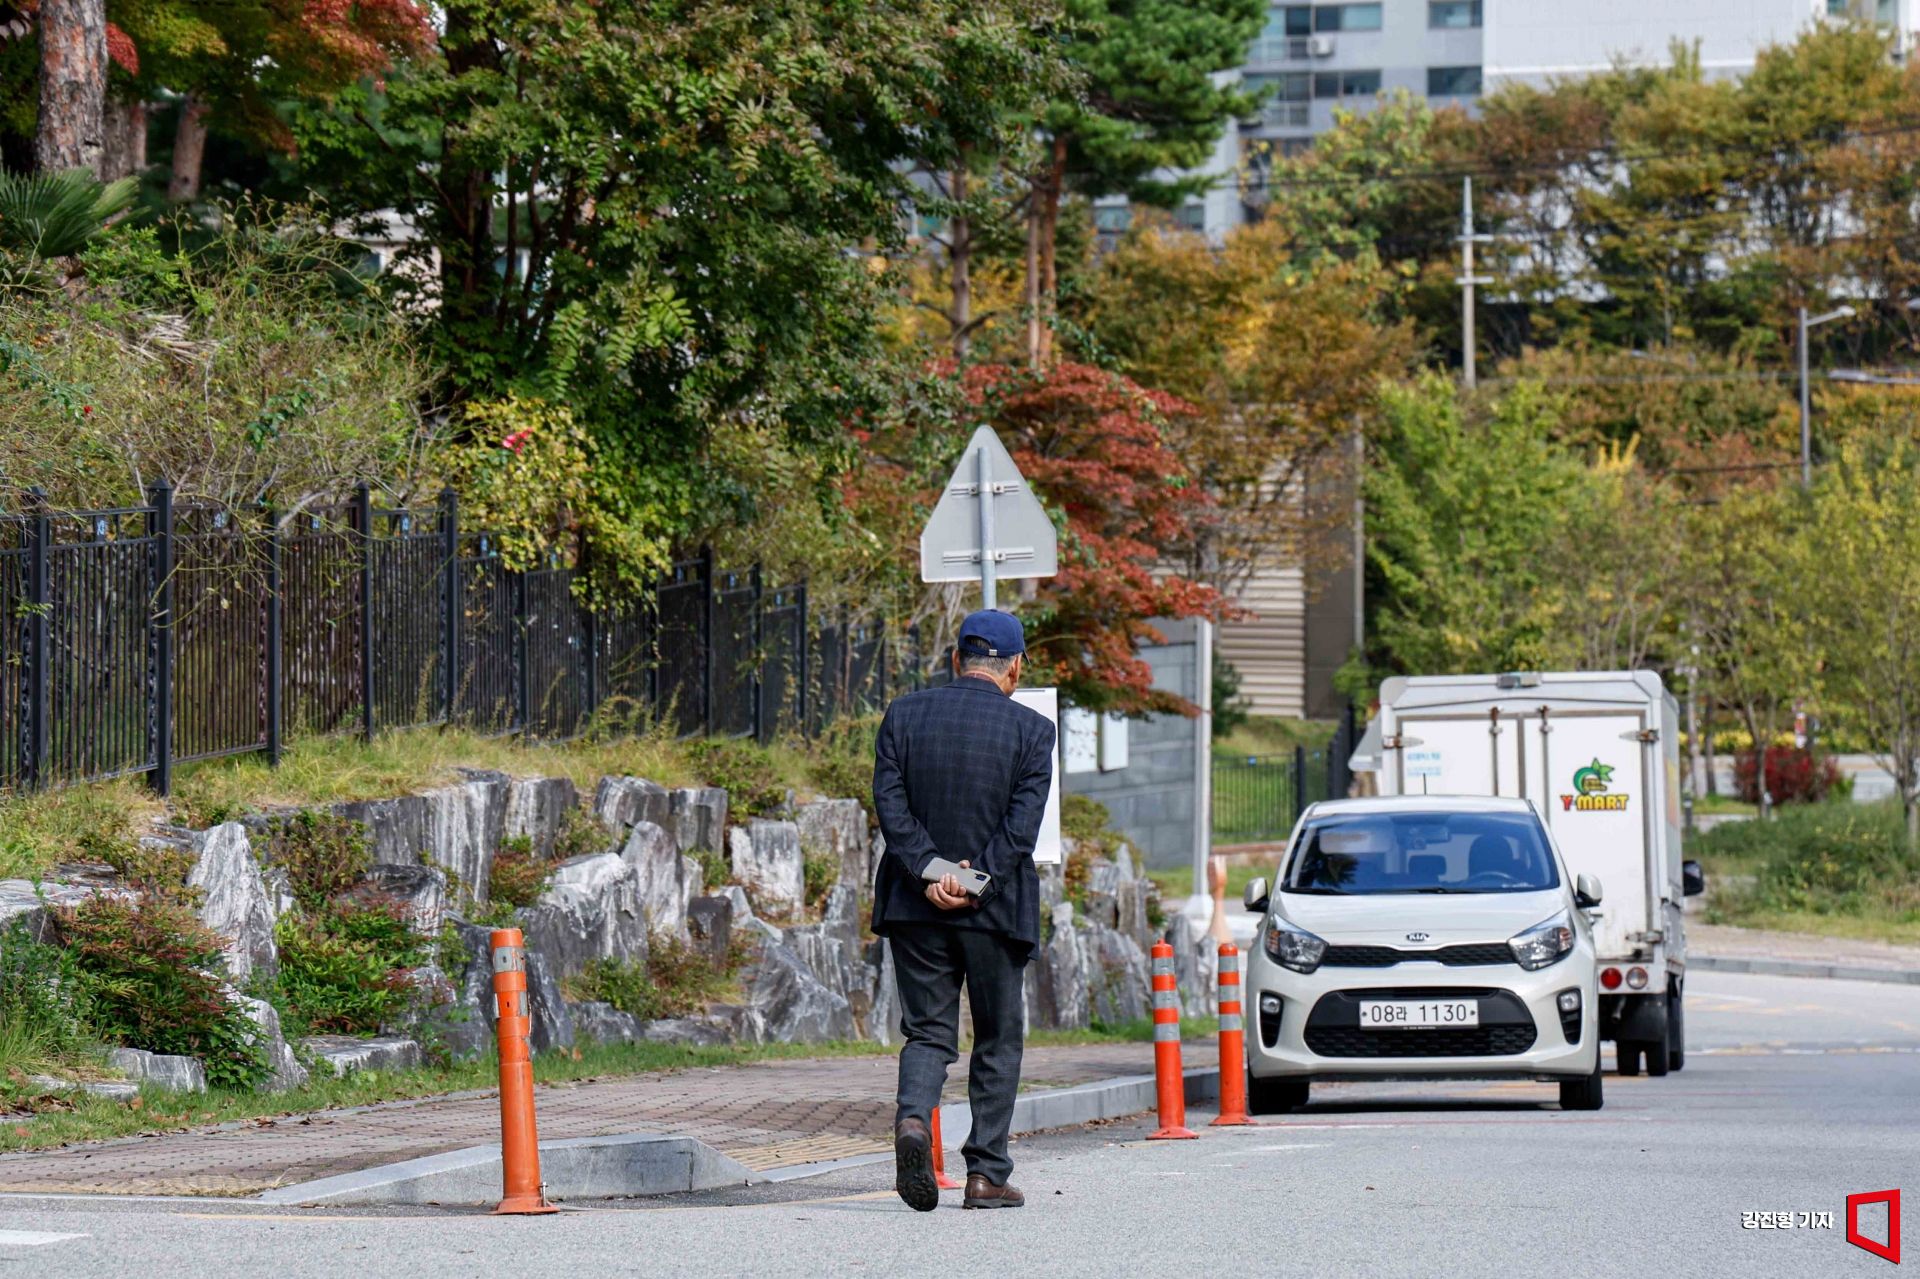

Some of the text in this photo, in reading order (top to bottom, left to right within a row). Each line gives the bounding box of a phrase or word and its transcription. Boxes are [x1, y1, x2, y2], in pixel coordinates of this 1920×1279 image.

[1560, 794, 1629, 811] Y MART
[1407, 932, 1431, 941] KIA
[1371, 1004, 1467, 1023] 08라 1130
